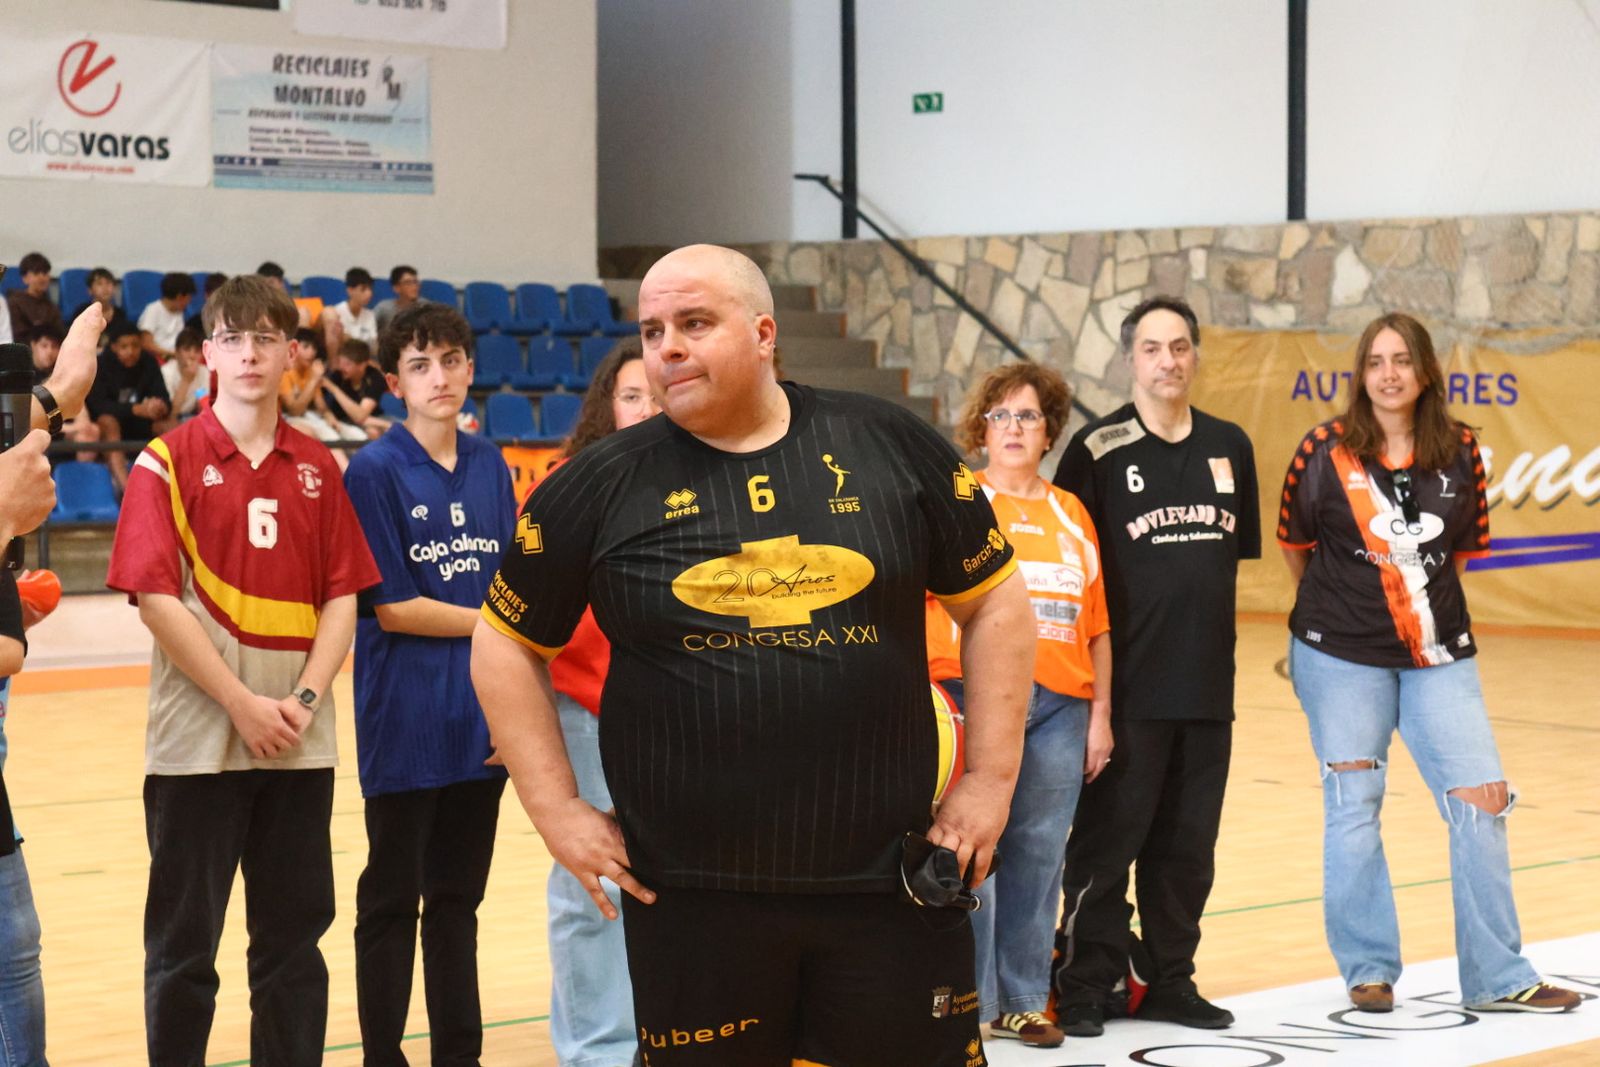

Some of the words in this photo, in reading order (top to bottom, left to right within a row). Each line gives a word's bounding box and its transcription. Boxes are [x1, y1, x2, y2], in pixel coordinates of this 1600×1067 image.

[272, 53, 370, 78] RECICLAJES
[274, 85, 366, 107] MONTALVO
[1126, 465, 1145, 493] 6
[747, 475, 775, 512] 6
[450, 502, 466, 527] 6
[665, 504, 700, 520] errea
[829, 501, 861, 514] 1995
[247, 497, 278, 549] 6
[409, 540, 449, 563] Caja
[712, 568, 779, 604] 20
[771, 589, 802, 600] building
[815, 586, 837, 595] future
[683, 629, 836, 652] CONGESA
[841, 624, 879, 645] XXI
